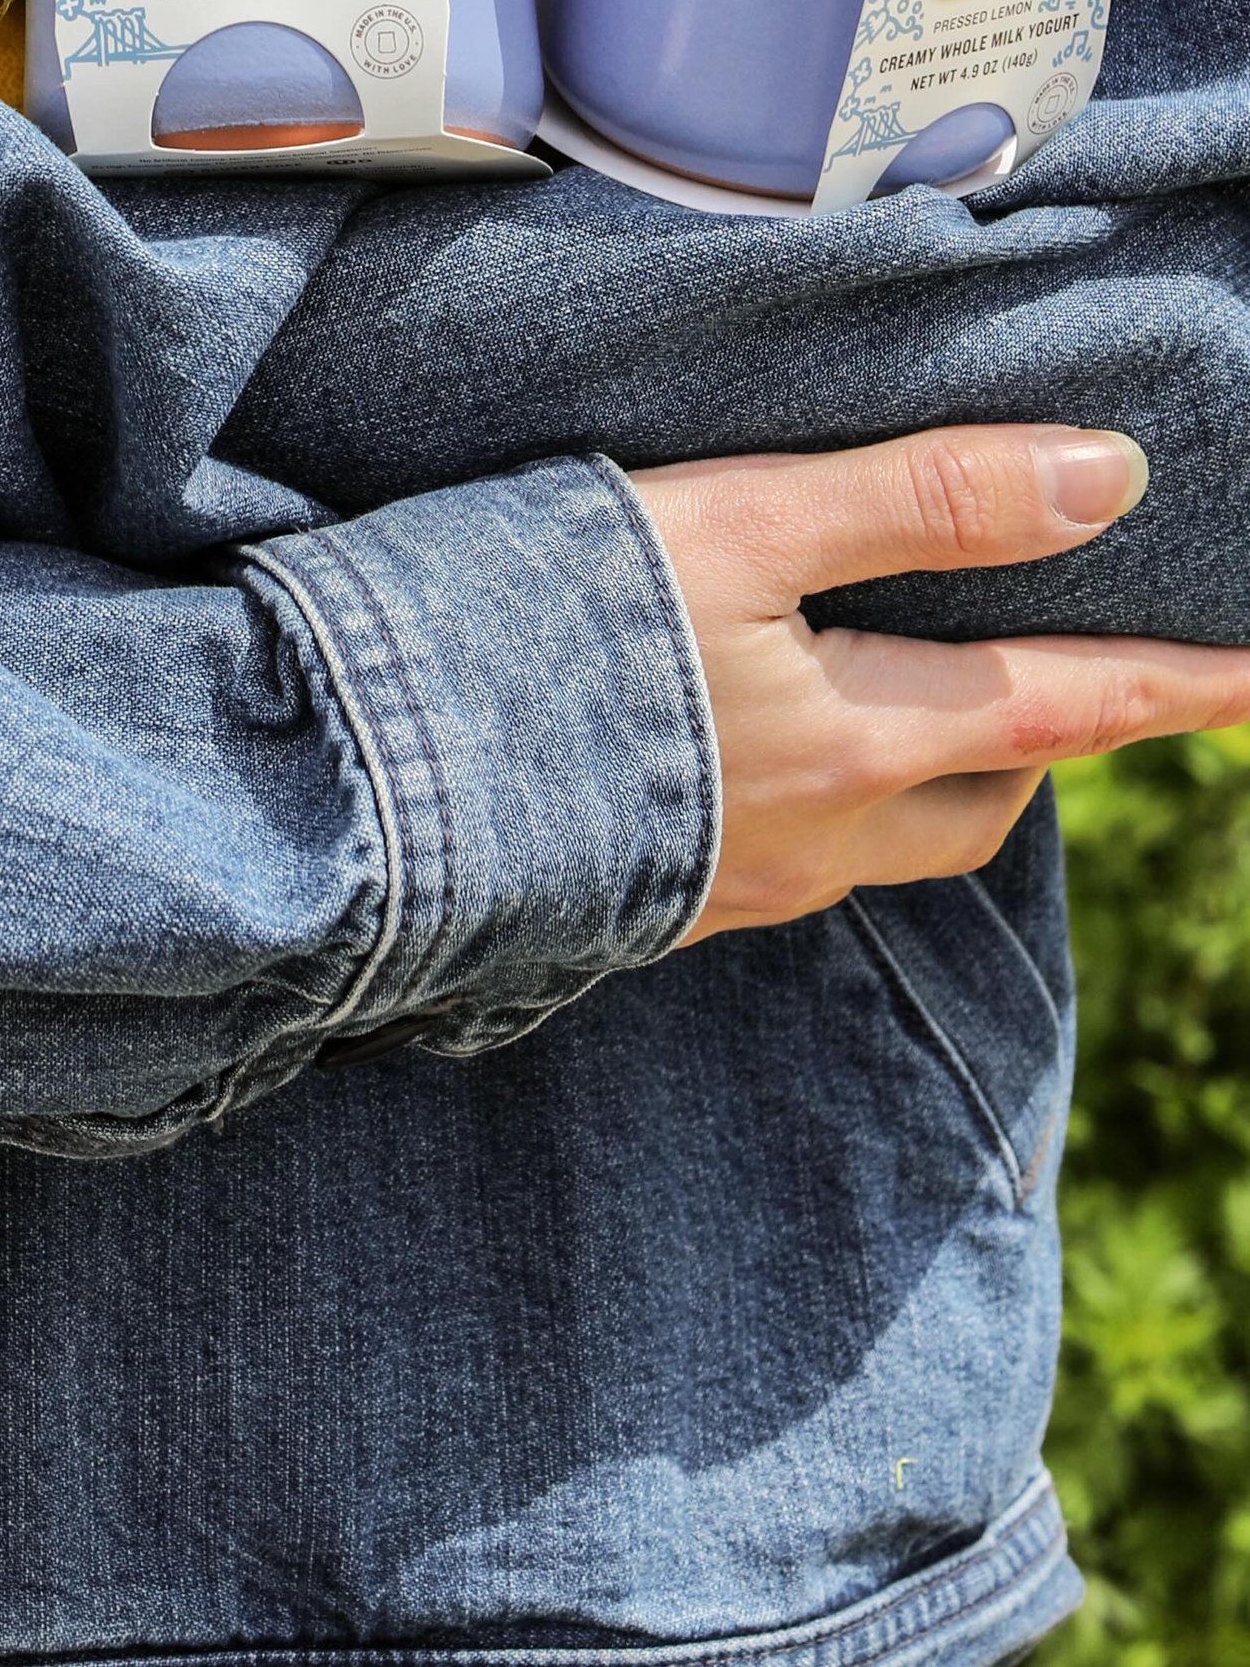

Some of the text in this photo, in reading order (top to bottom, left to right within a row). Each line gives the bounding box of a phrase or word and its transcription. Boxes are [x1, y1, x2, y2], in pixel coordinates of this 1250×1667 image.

[355, 14, 374, 38] MADE
[375, 9, 384, 18] IN
[387, 9, 405, 20] THE
[933, 0, 1033, 34] PRESSED LEMON
[879, 13, 1080, 74] CREAMY WHOLE MILK YOGURT
[364, 54, 417, 74] WITH LOVE
[910, 48, 1038, 92] NET WT 4.9 OZ (140g)
